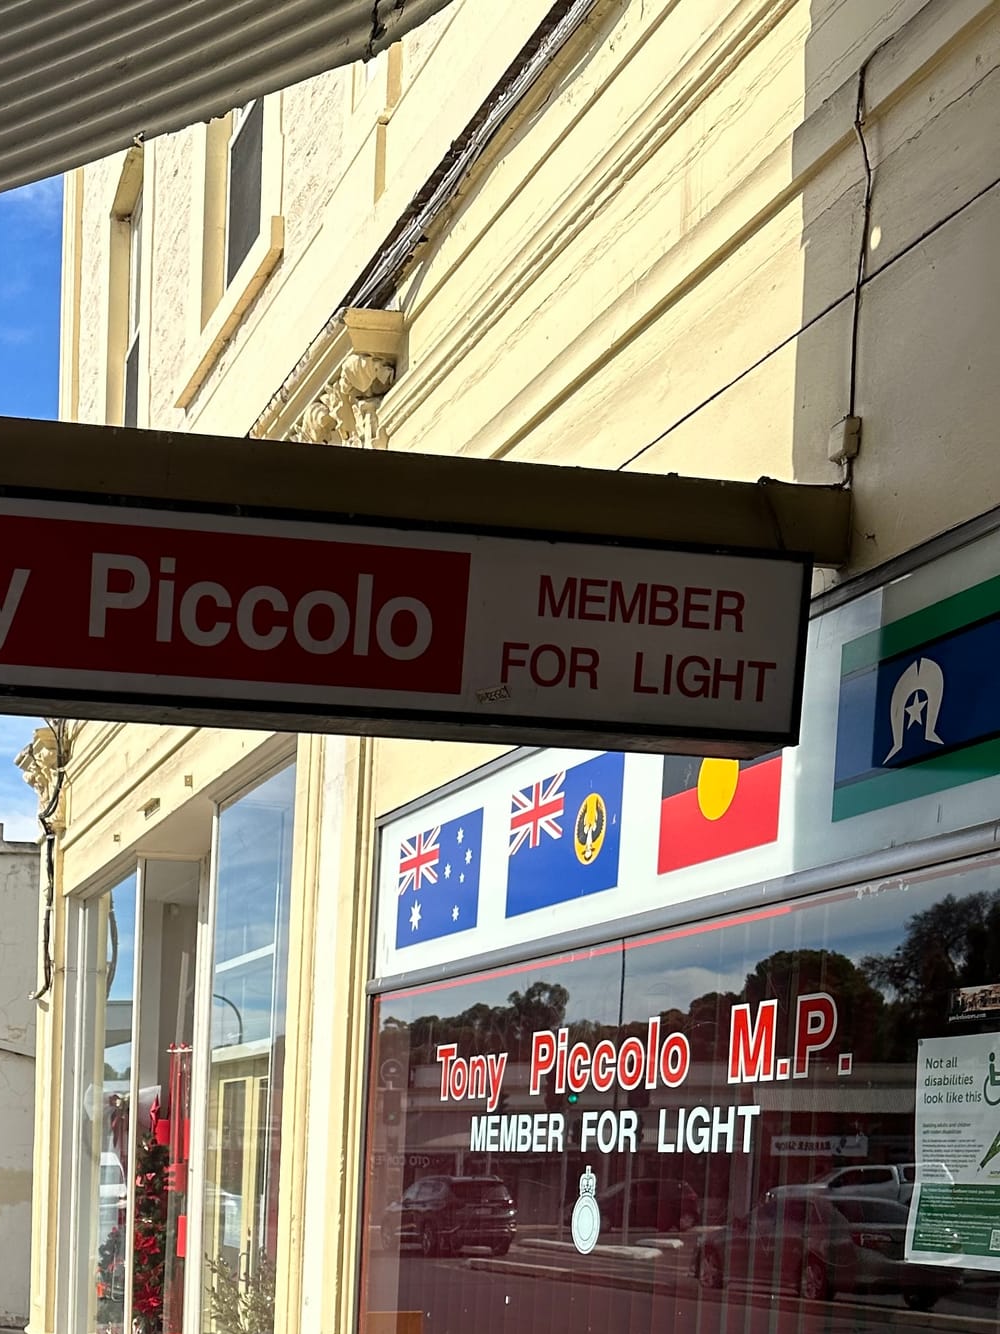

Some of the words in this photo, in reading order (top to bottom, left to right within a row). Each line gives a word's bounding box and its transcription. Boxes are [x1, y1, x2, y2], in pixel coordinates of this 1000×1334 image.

[88, 552, 434, 661] Piccolo
[538, 574, 746, 633] MEMBER
[500, 642, 600, 691] FOR
[633, 653, 777, 702] LIGHT
[436, 1042, 509, 1113] Tony
[529, 1016, 690, 1096] Piccolo
[727, 992, 853, 1084] M.P.
[926, 1057, 943, 1069] Not
[945, 1056, 958, 1069] all
[924, 1074, 974, 1087] disabilities
[924, 1091, 943, 1104] look
[946, 1091, 964, 1104] like
[965, 1090, 982, 1103] this
[470, 1112, 564, 1152] MEMBER
[580, 1110, 638, 1153] FOR
[658, 1105, 760, 1153] LIGHT
